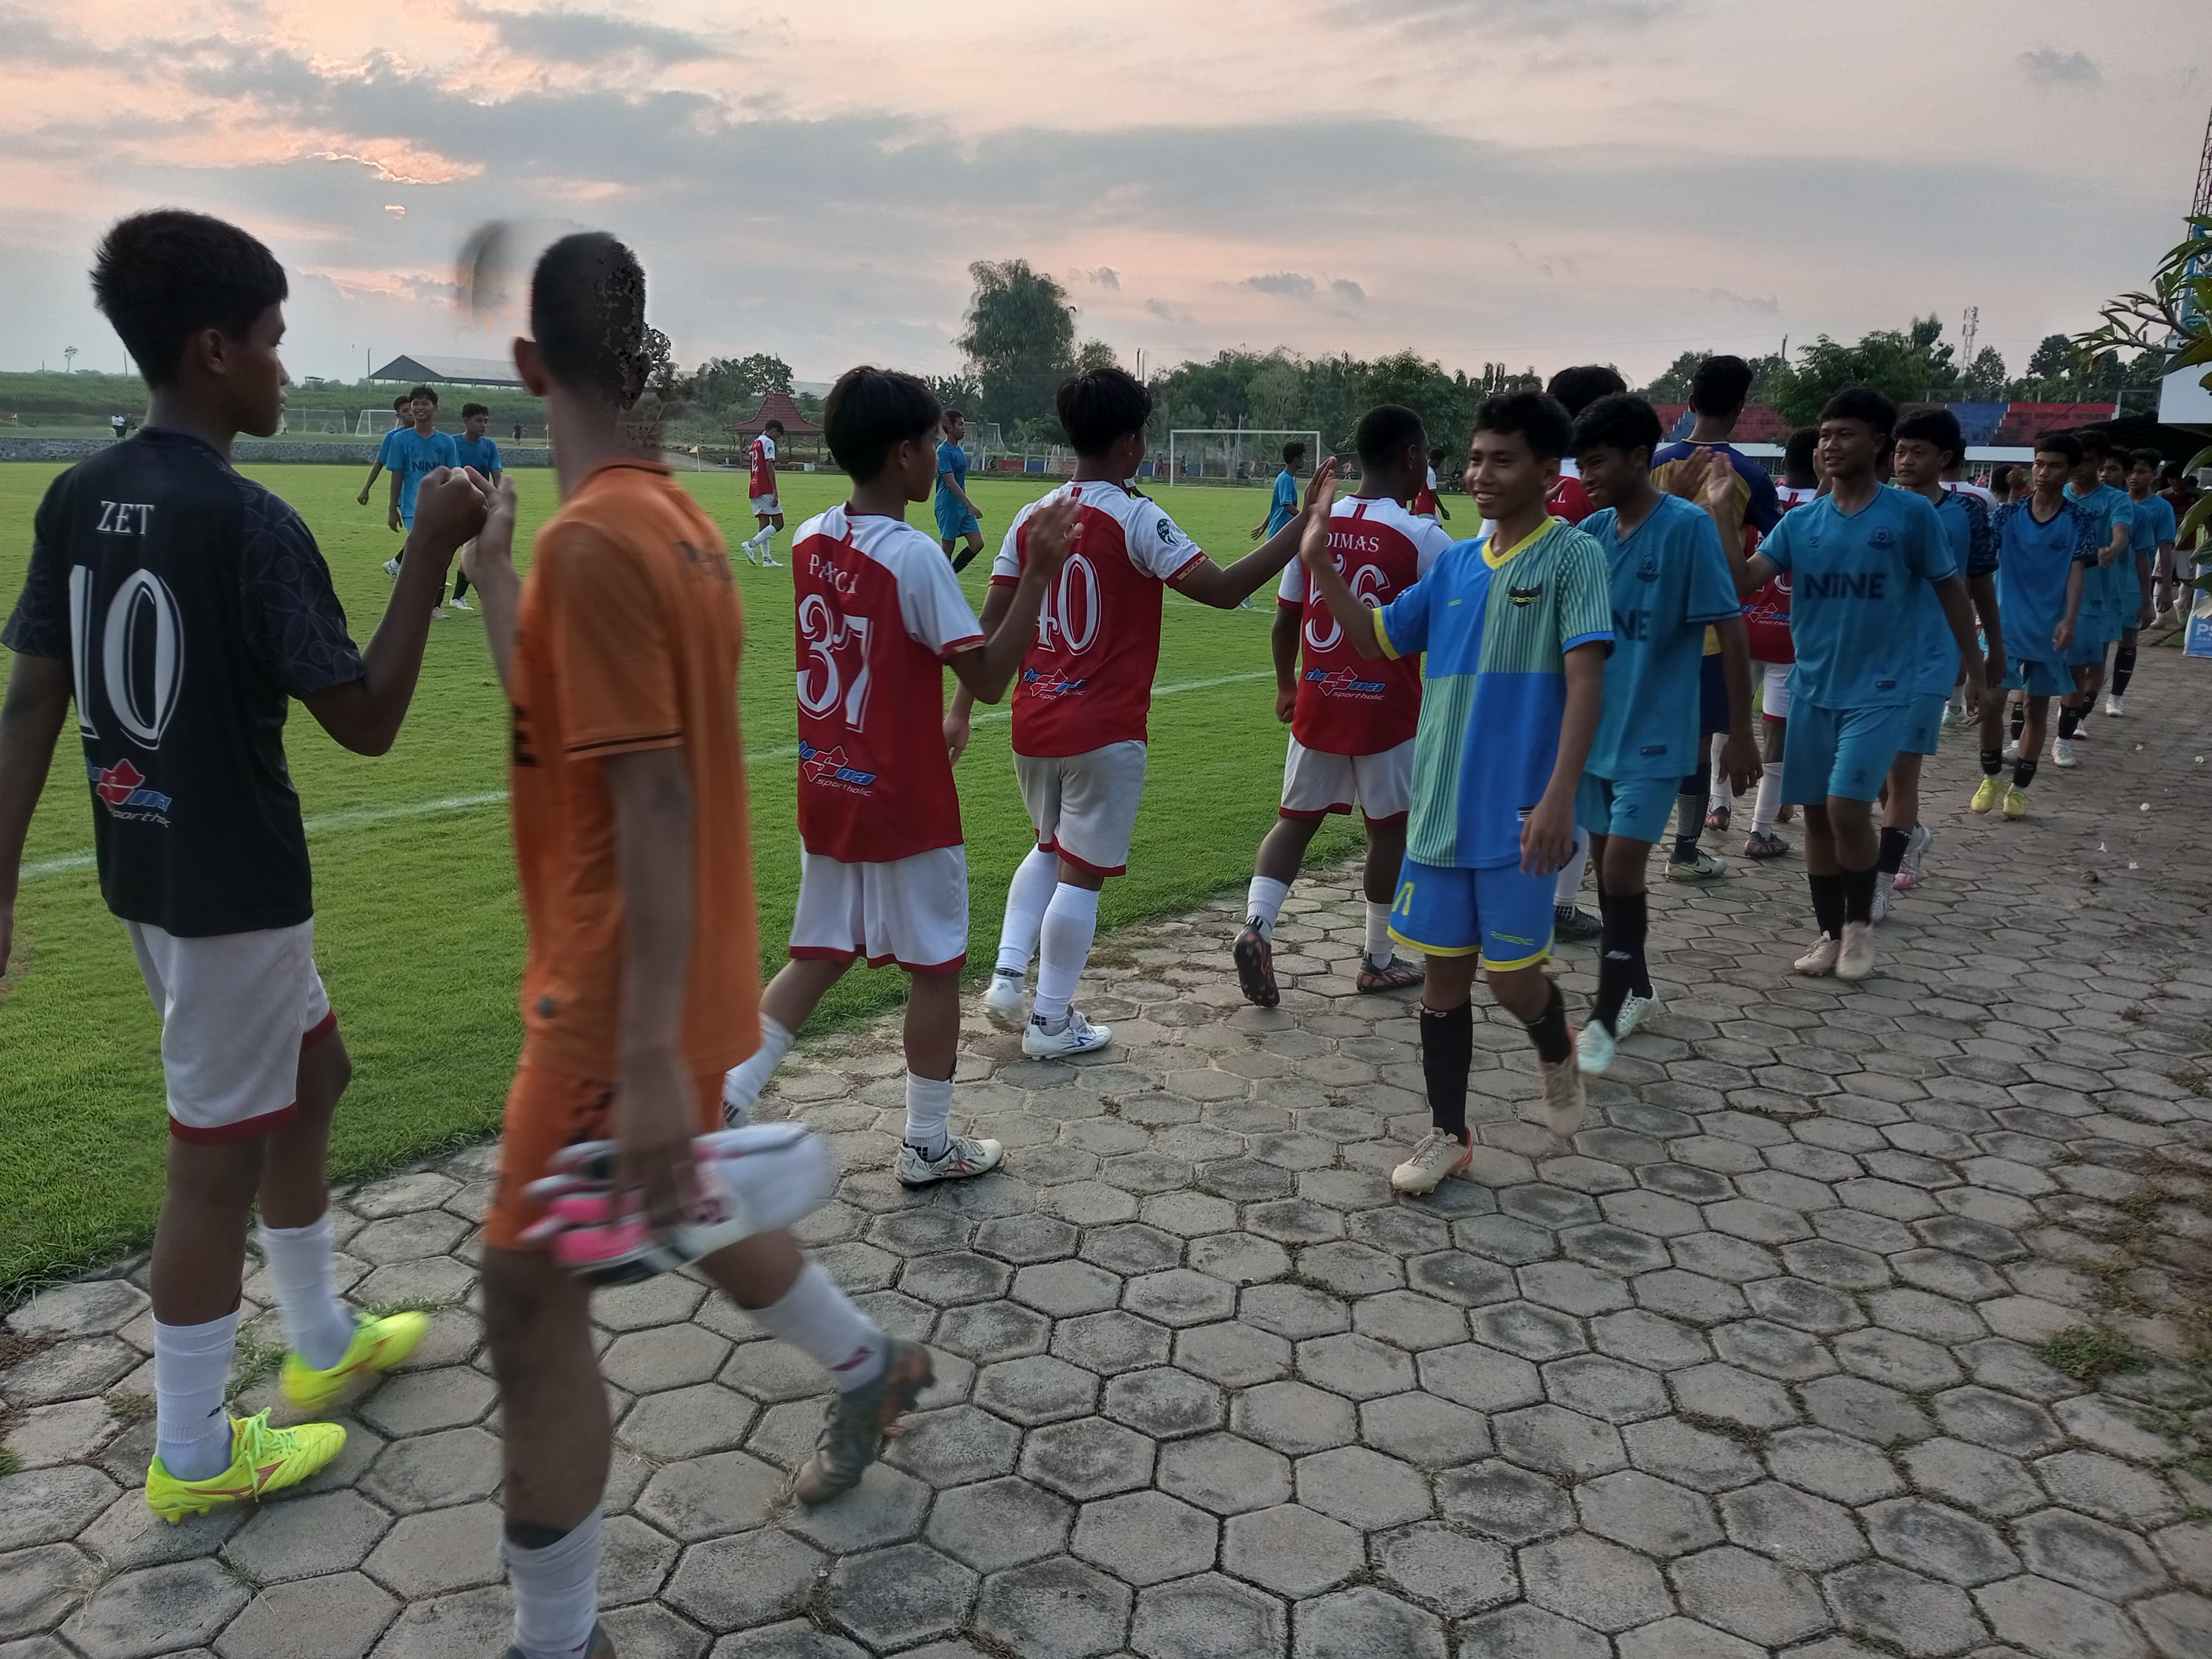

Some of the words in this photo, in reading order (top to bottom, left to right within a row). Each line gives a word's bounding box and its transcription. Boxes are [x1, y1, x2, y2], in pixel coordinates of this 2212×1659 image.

[96, 500, 155, 536] ZET
[1804, 573, 1886, 599] NINE
[69, 564, 184, 750] 10
[797, 594, 874, 733] 37
[1332, 691, 1385, 700] sportholic
[816, 779, 874, 796] sportholic
